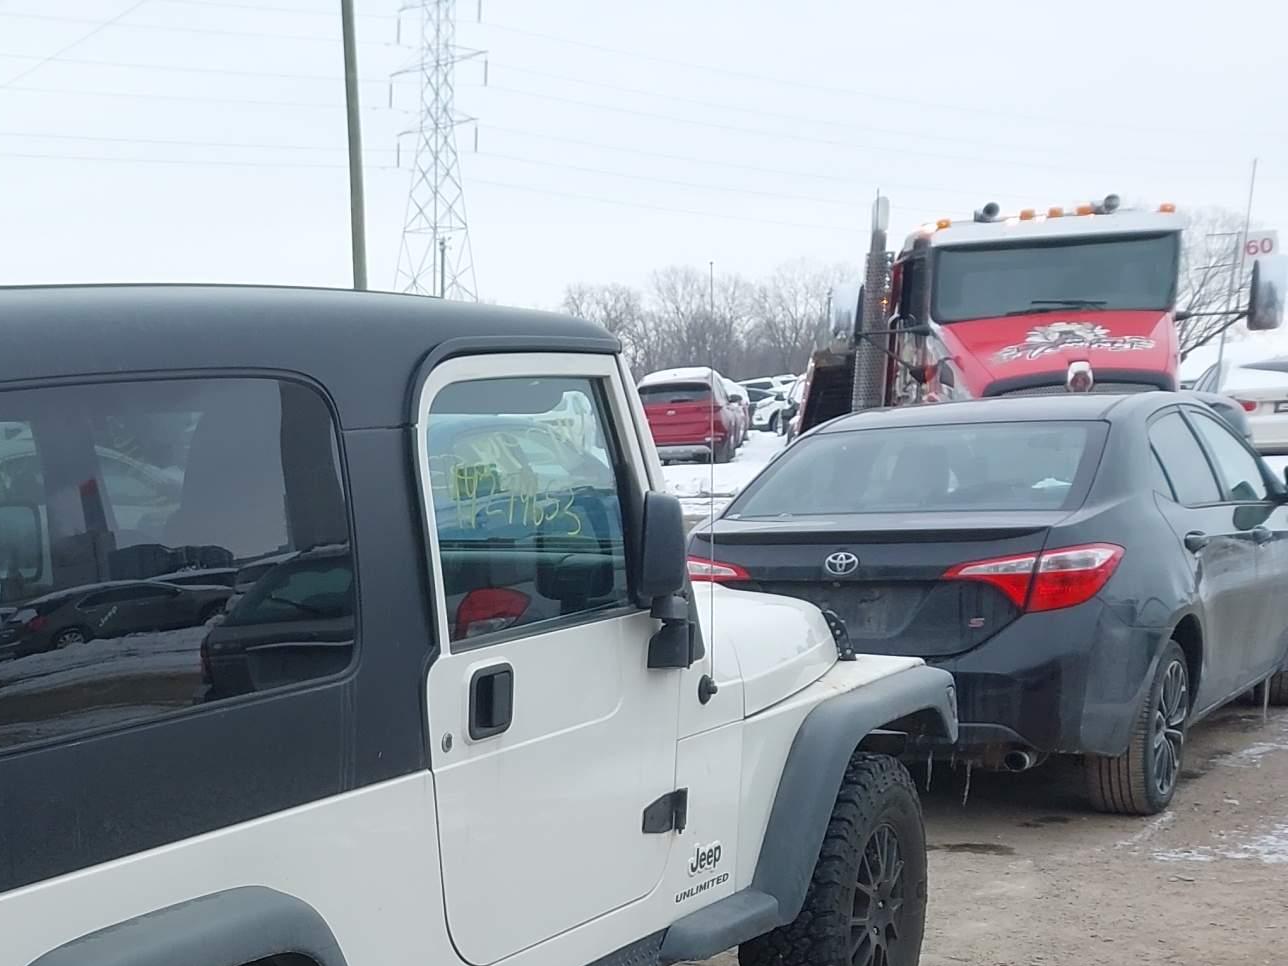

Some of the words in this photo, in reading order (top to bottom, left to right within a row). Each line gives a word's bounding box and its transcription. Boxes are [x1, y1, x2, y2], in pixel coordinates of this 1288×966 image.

[1246, 237, 1273, 256] 60
[690, 844, 722, 873] Jeep
[675, 872, 729, 903] UNLIMITED
